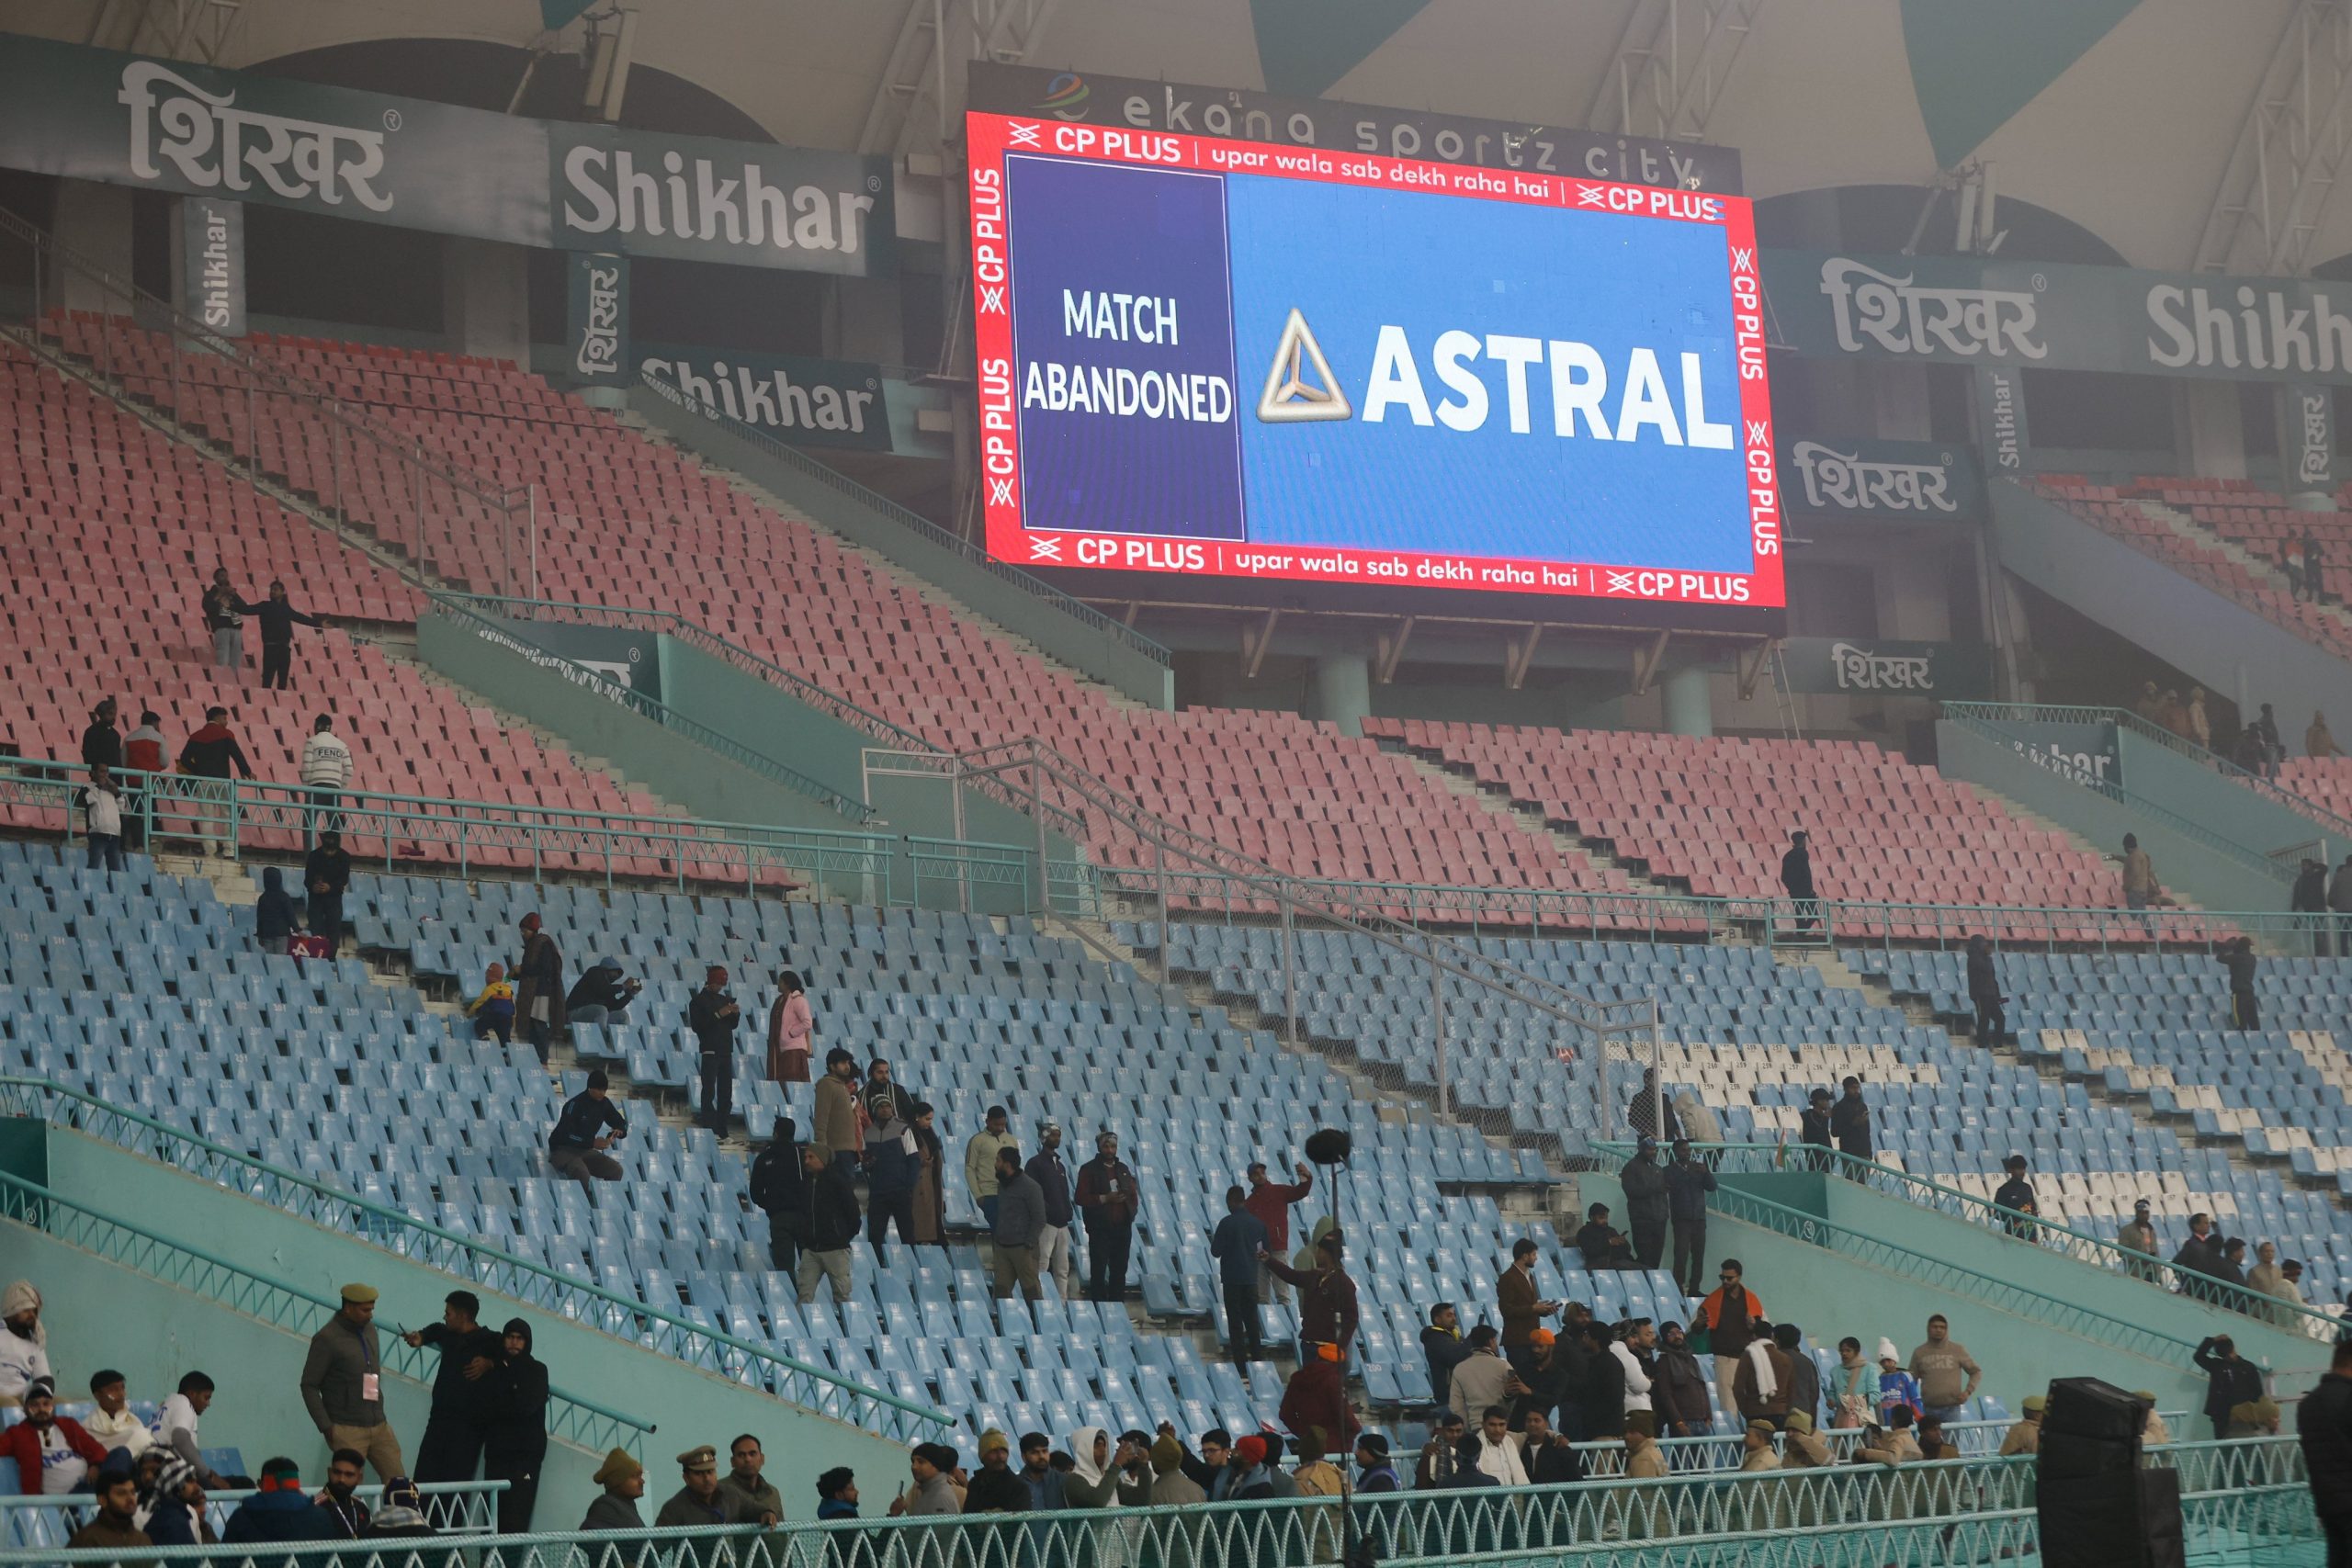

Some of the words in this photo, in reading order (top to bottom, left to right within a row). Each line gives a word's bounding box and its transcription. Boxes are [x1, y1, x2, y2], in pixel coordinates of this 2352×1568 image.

[118, 61, 393, 212] शिखर
[1123, 85, 1315, 145] ekana
[1356, 120, 1556, 172] sportz
[1585, 140, 1694, 189] city
[564, 145, 874, 254] Shikhar
[974, 168, 1002, 239] PLUS
[1055, 127, 1095, 152] CP
[1103, 132, 1182, 163] PLUS
[1211, 147, 1268, 170] upar
[1275, 153, 1333, 175] wala
[1340, 156, 1382, 180] sab
[1390, 165, 1447, 186] dekh
[1454, 170, 1507, 194] raha
[1514, 177, 1549, 198] hai
[1608, 189, 1645, 211] CP
[1650, 192, 1718, 221] PLUS
[205, 207, 231, 329] Shikhar
[978, 244, 1005, 282] CP
[1733, 276, 1758, 310] CP
[577, 266, 619, 376] शिखर
[1062, 288, 1180, 346] MATCH
[1820, 257, 2048, 360] शिखर
[2146, 284, 2352, 373] Shikh
[1736, 314, 1764, 381] PLUS
[982, 357, 1012, 431] PLUS
[1023, 361, 1232, 423] ABANDONED
[1362, 323, 1735, 451] ASTRAL
[1995, 373, 2020, 469] Shikhar
[987, 435, 1014, 475] CP
[1747, 449, 1771, 484] CP
[2300, 393, 2331, 484] शिखर
[1793, 441, 1957, 513] शिखर
[1750, 488, 1778, 556] PLUS
[1077, 536, 1118, 564] CP
[1126, 540, 1205, 570] PLUS
[1236, 553, 1293, 576] upar
[1300, 553, 1359, 575] wala
[1367, 558, 1408, 578] sab
[1416, 558, 1474, 581] dekh
[1481, 566, 1535, 585] raha
[1543, 568, 1577, 587] hai
[1638, 572, 1674, 596] CP
[1680, 573, 1749, 602] PLUS
[1831, 642, 1933, 689] शिखर
[1881, 1388, 1901, 1397] pollo
